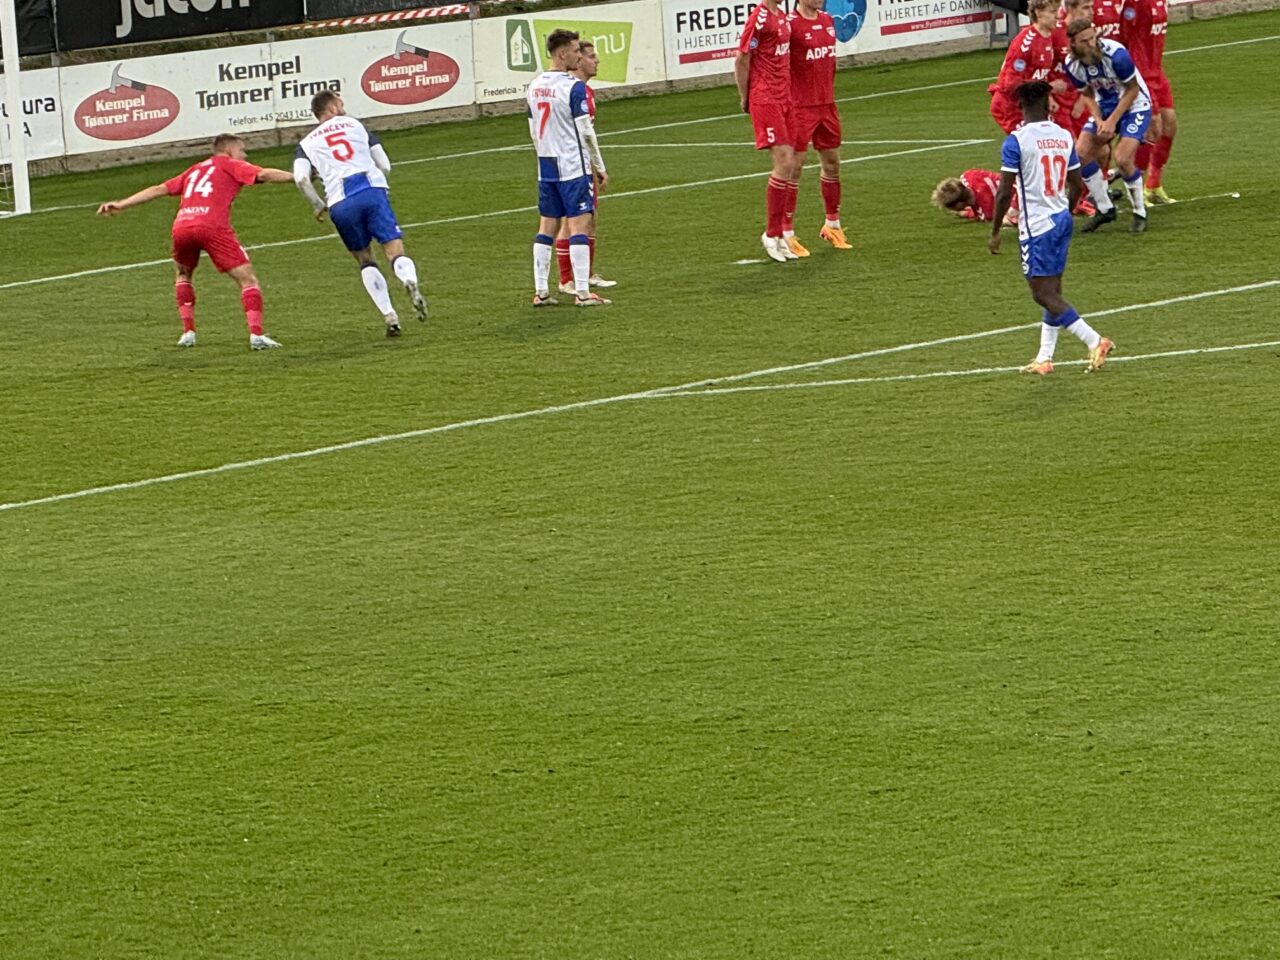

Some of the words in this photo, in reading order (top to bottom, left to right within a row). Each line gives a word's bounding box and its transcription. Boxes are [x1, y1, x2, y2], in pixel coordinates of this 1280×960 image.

[885, 4, 930, 21] HJERTET
[933, 0, 948, 14] AF
[684, 34, 729, 49] HJERTET
[218, 55, 301, 82] Kempel
[381, 60, 428, 77] Kempel
[368, 78, 412, 93] Tømrer
[415, 74, 450, 87] Firma
[483, 86, 517, 97] Fredericia
[95, 94, 146, 112] Kempel
[195, 86, 273, 111] Tømrer
[281, 78, 342, 99] Firma
[82, 113, 130, 128] Tømrer
[132, 108, 170, 121] Firma
[537, 101, 551, 140] 7
[766, 127, 776, 143] 5
[1036, 138, 1068, 150] DEEDSON
[324, 131, 355, 162] 5
[184, 165, 216, 199] 14
[1040, 154, 1066, 198] 17
